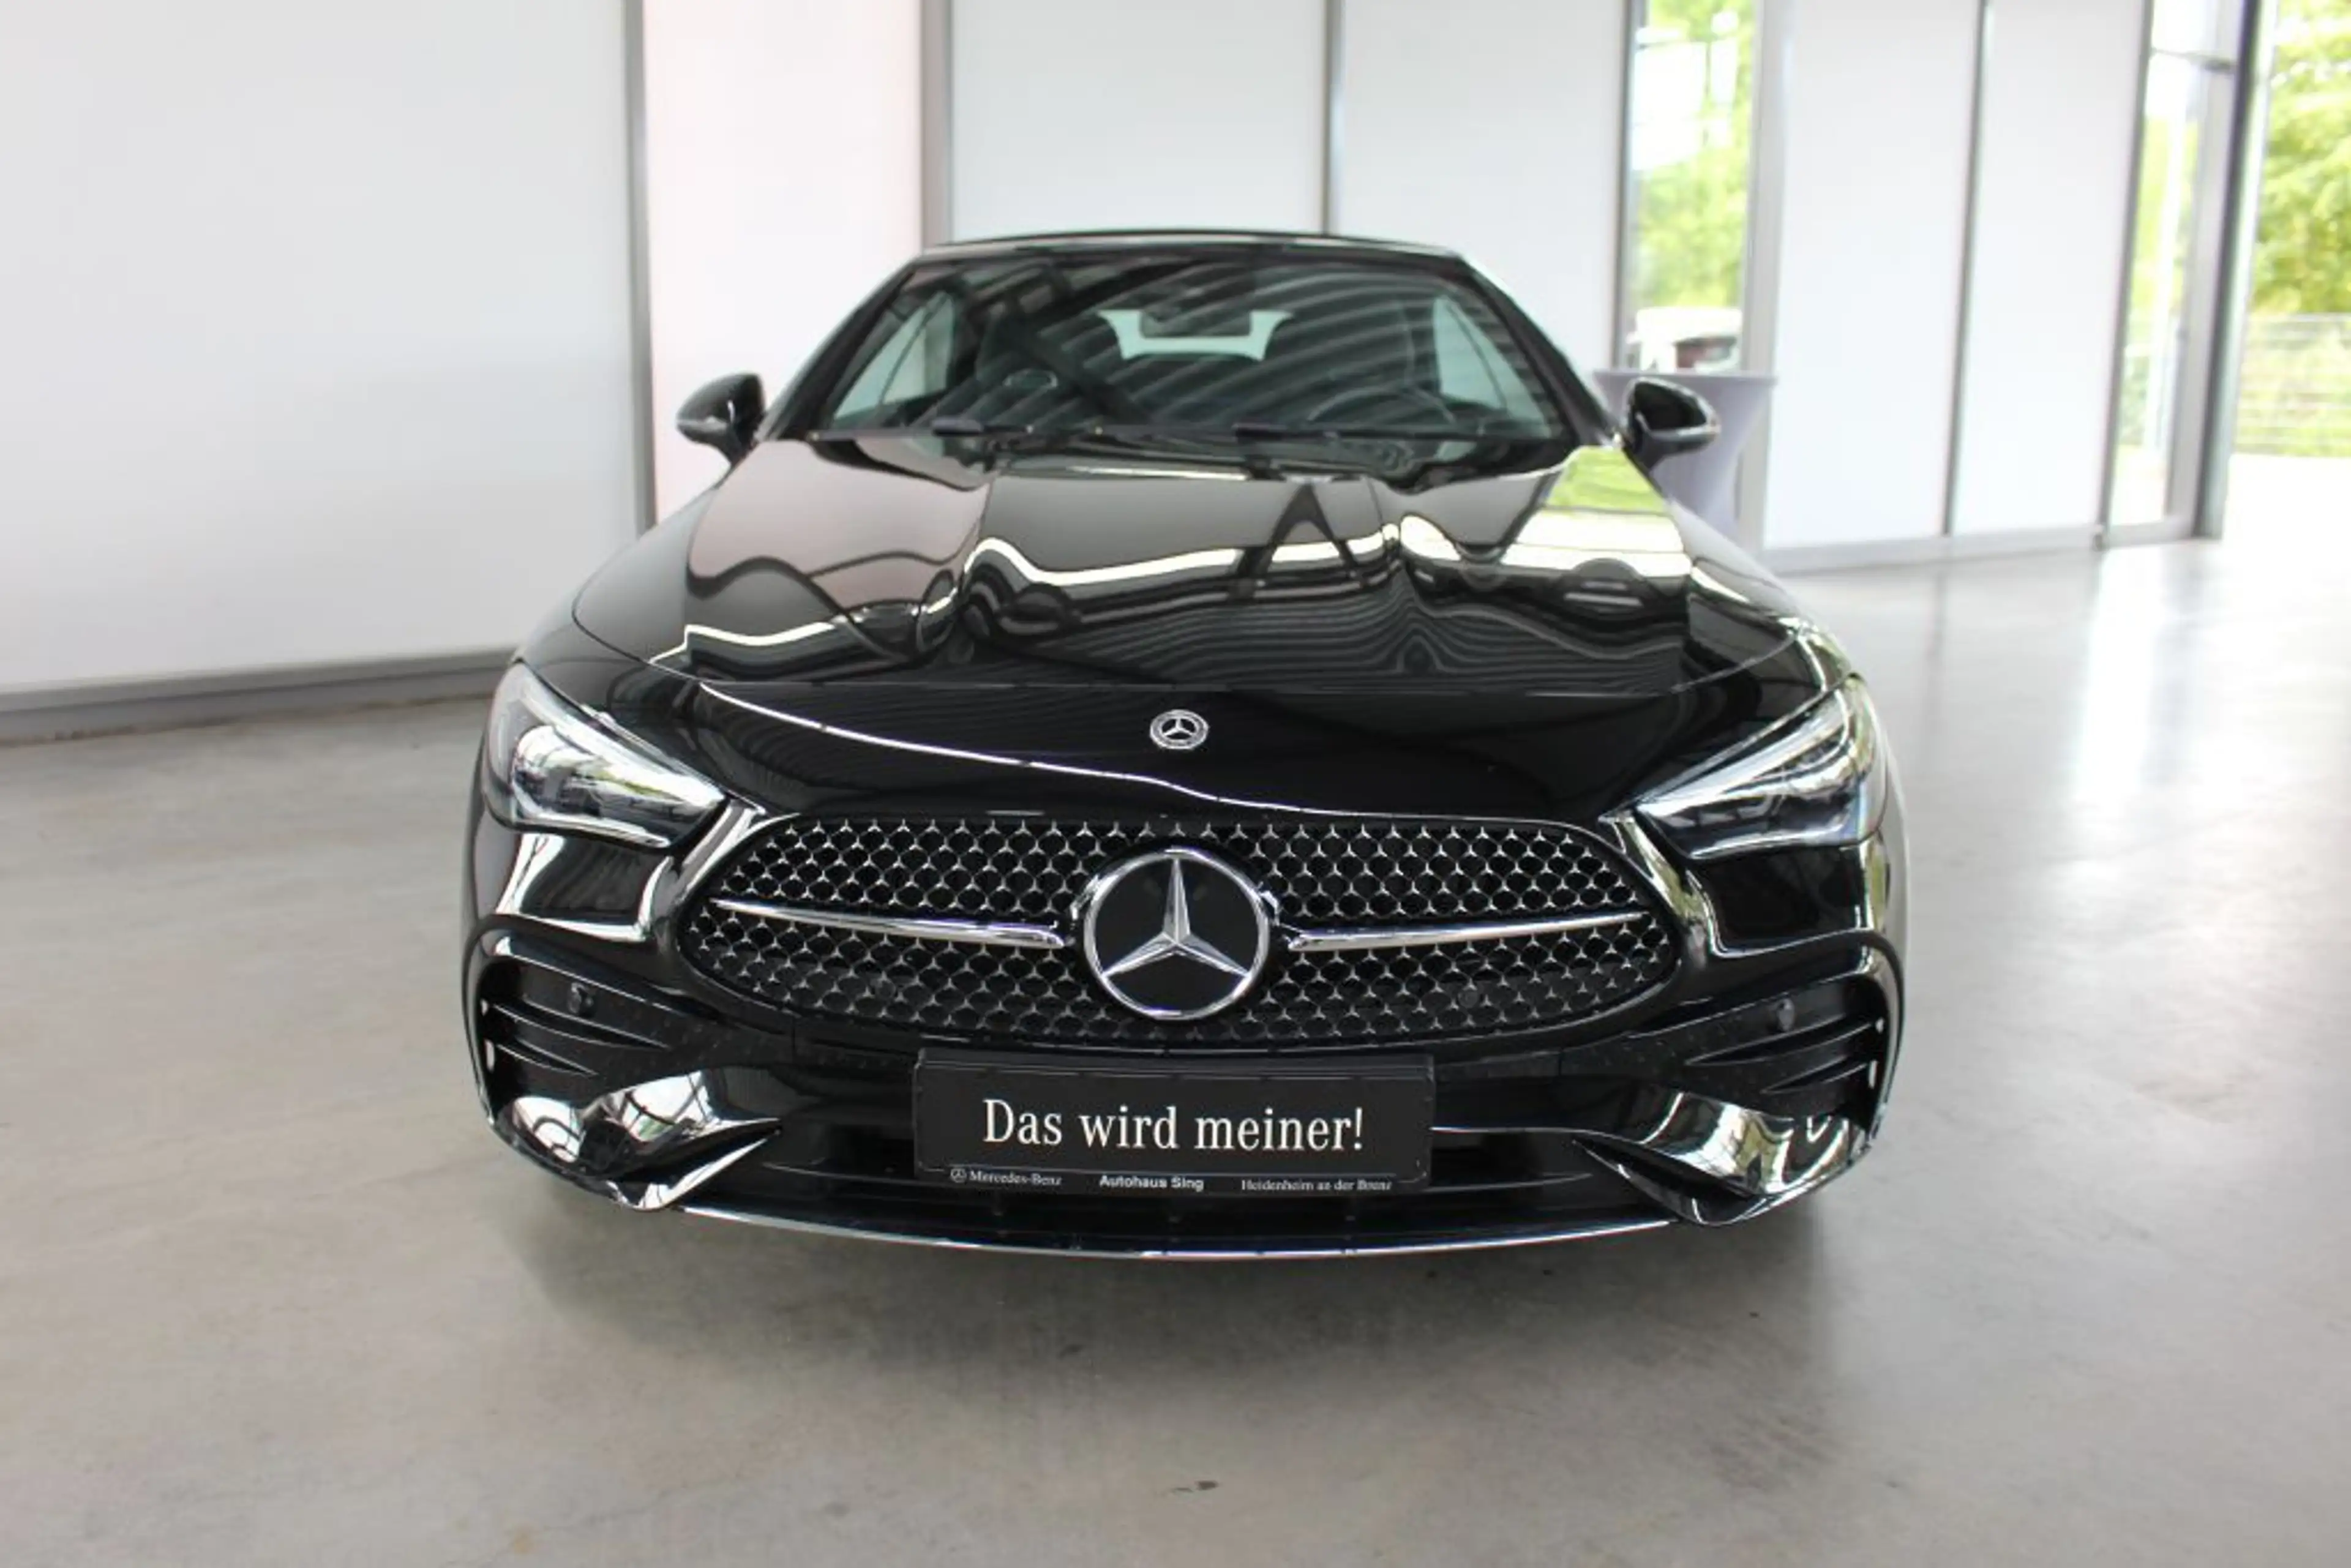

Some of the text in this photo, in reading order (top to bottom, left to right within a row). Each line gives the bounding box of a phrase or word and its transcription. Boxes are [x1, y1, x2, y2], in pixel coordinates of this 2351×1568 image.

[983, 1099, 1363, 1150] Das wird meiner!
[969, 1170, 1063, 1186] Mercedes-Benz
[1100, 1175, 1204, 1192] Autohaus Sing
[1241, 1179, 1314, 1191] Heidenheim
[1333, 1179, 1354, 1191] der
